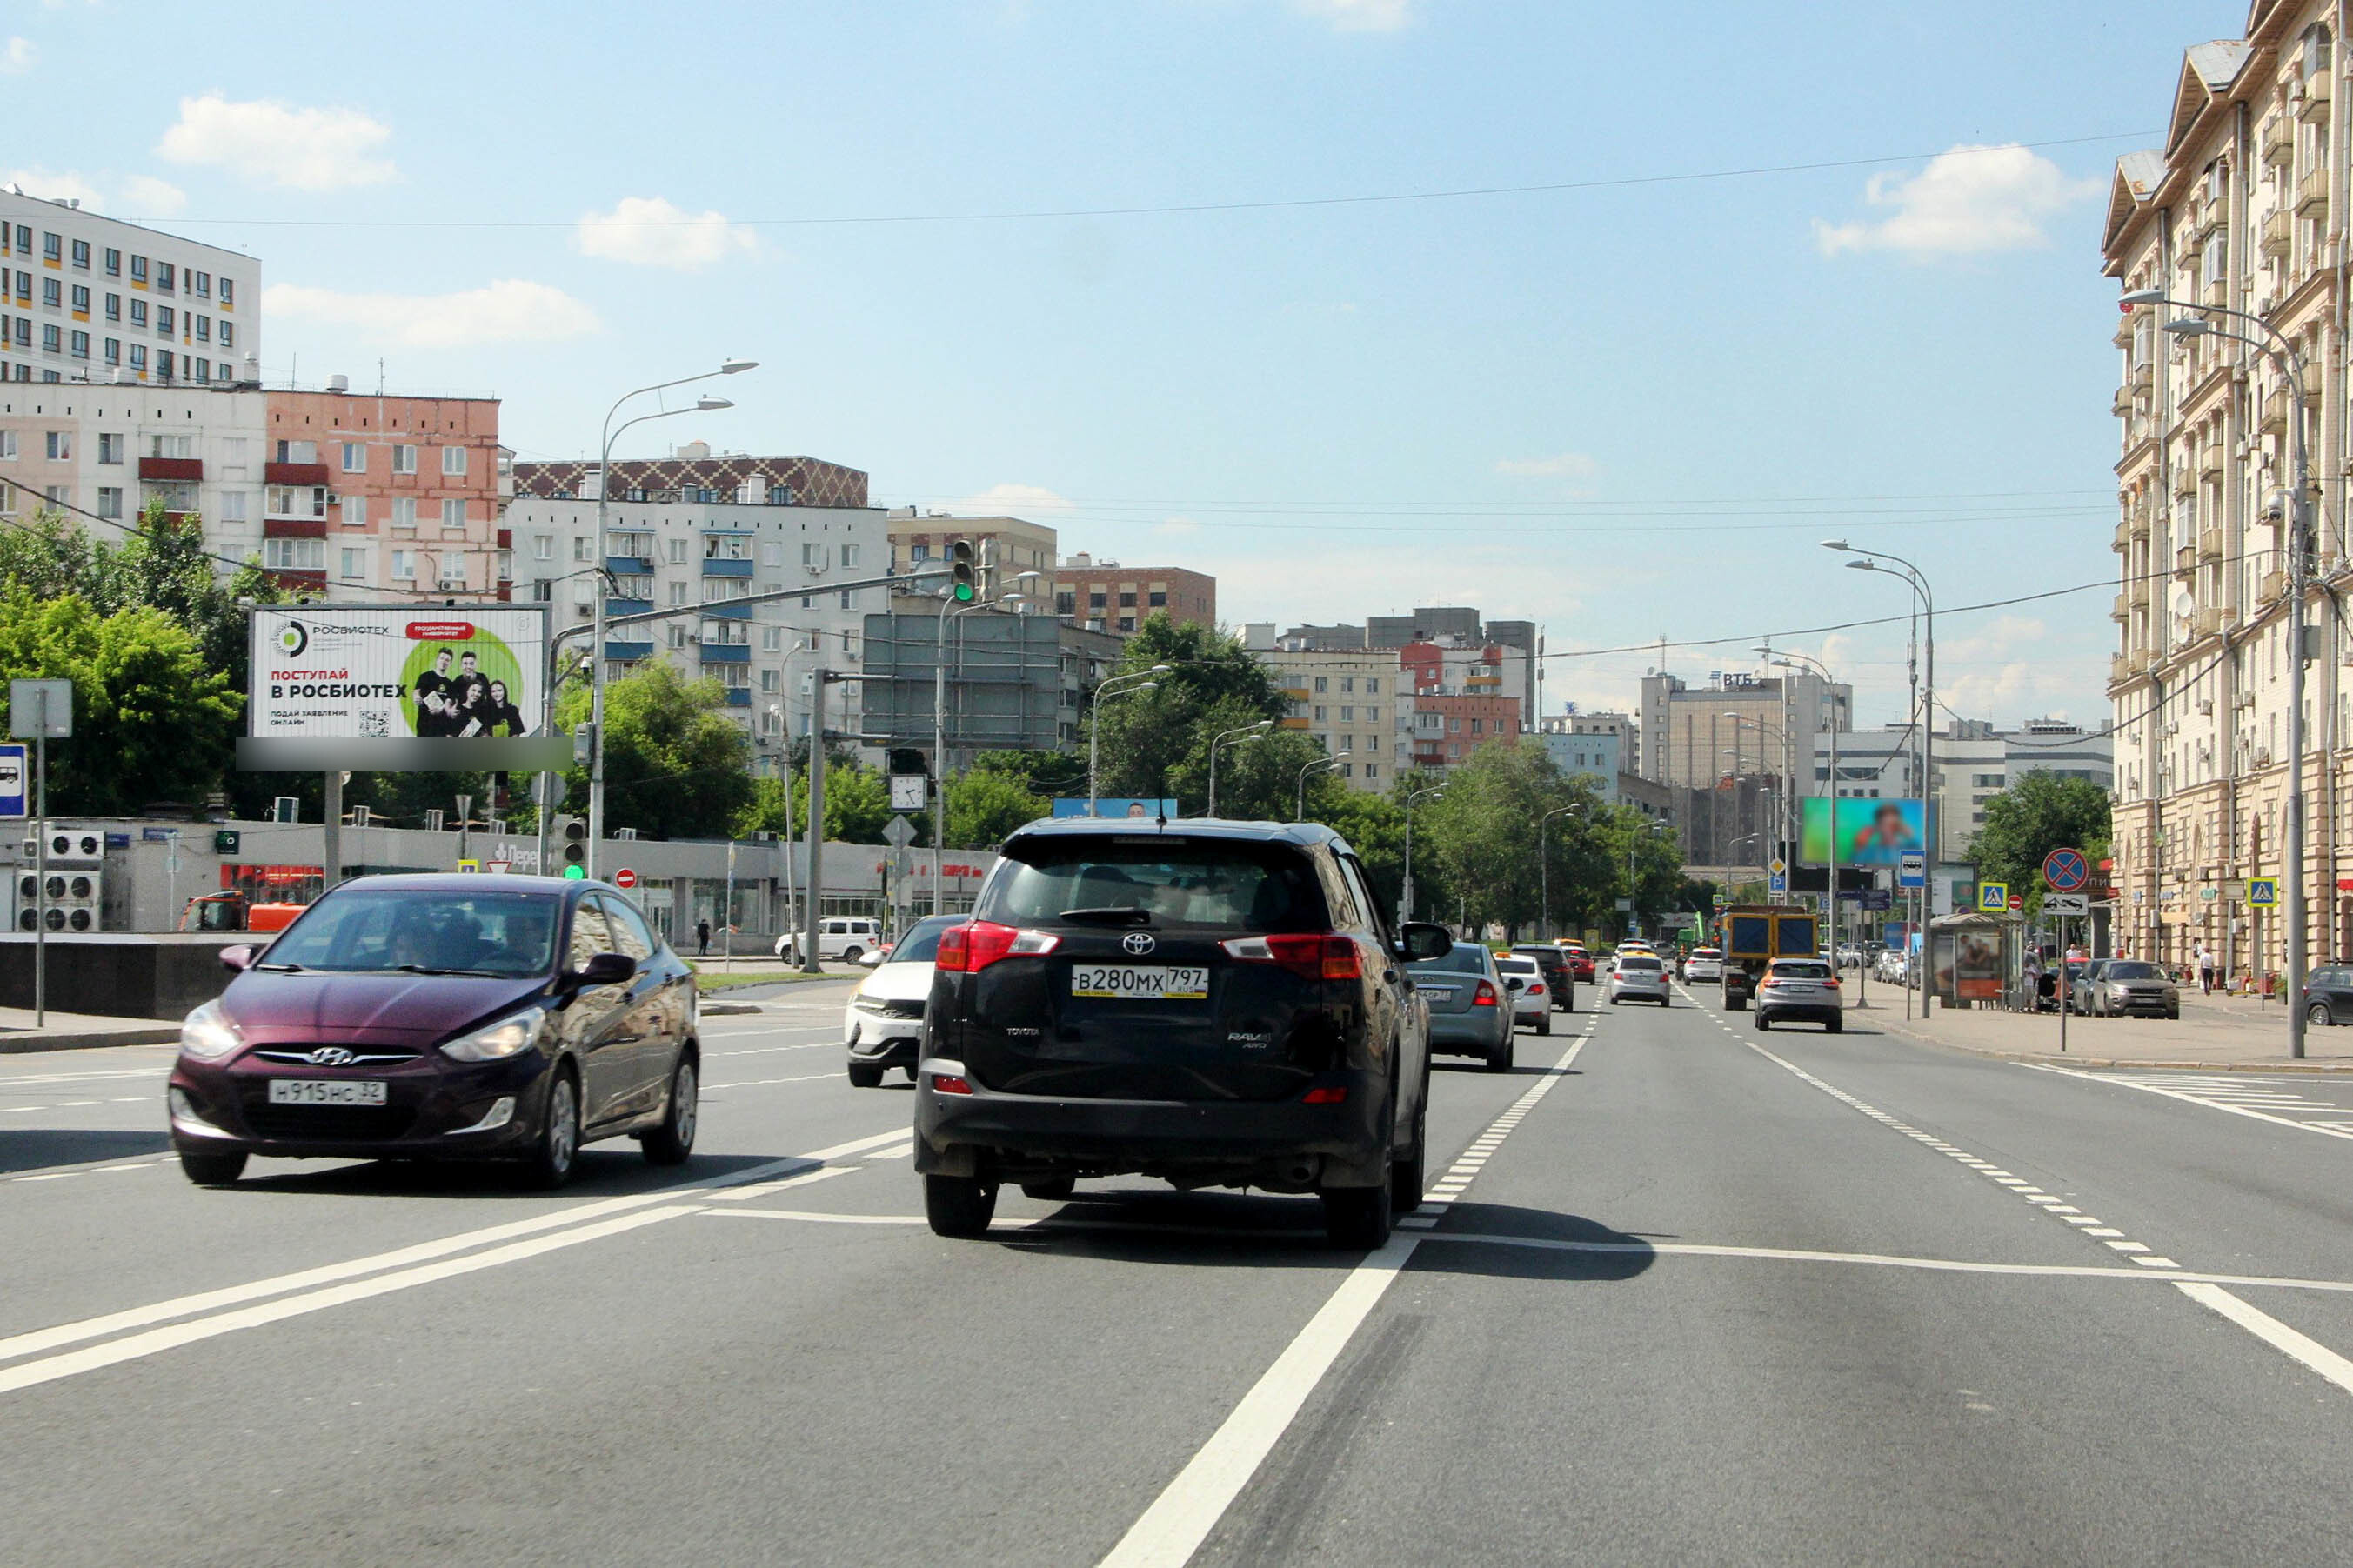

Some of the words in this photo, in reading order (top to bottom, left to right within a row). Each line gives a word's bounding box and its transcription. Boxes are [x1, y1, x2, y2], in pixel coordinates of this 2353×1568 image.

[271, 668, 349, 681] ПОСТУПАЙ
[1723, 673, 1753, 686] ВТБ
[271, 685, 283, 698] В
[289, 684, 407, 698] РОСБИОТЕХ
[1079, 969, 1164, 991] В280МХ
[1169, 969, 1202, 986] 797
[1006, 1027, 1041, 1036] TOYOTA
[1227, 1032, 1273, 1042] RAV4
